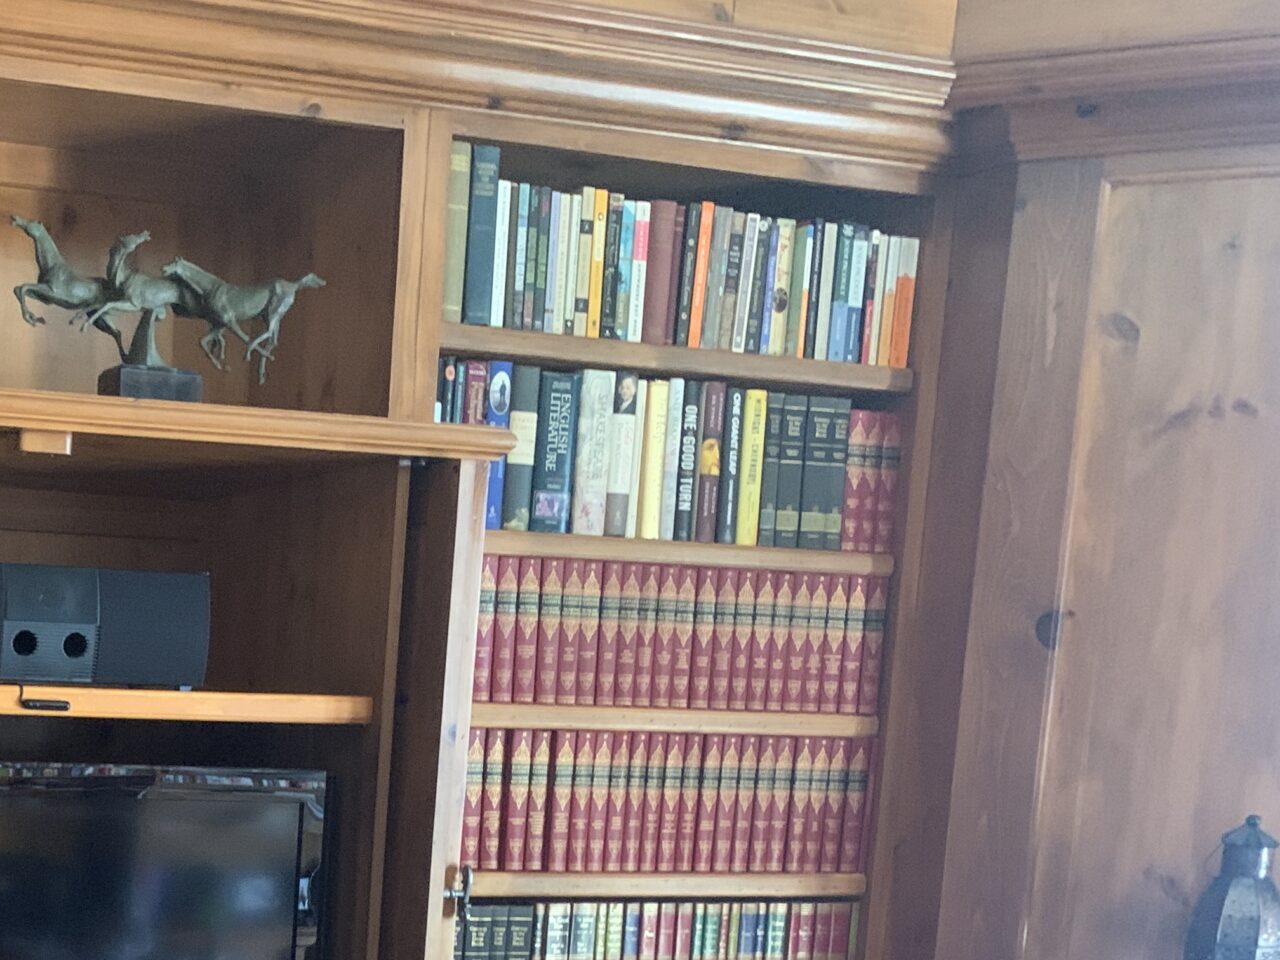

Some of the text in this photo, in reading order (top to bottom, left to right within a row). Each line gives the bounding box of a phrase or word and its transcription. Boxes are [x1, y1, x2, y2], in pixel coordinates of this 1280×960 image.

[558, 393, 572, 455] ENGLISH
[732, 392, 742, 416] ONE
[545, 392, 562, 473] LITERATURE
[730, 417, 740, 449] GIANT
[678, 404, 698, 512] ONE GOOD TURN
[728, 450, 738, 476] LEAP
